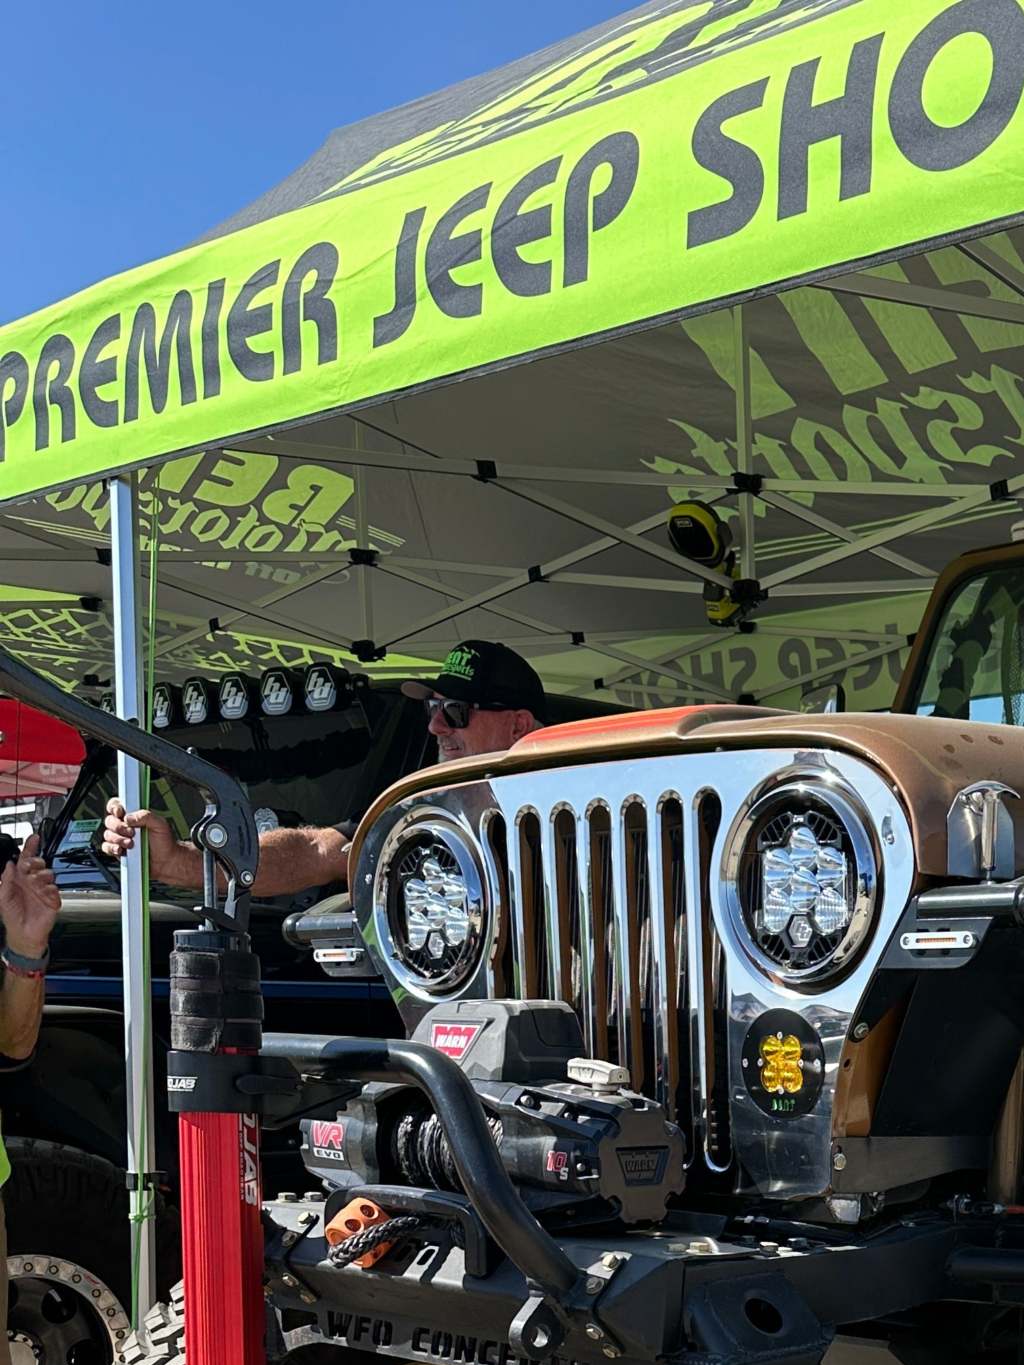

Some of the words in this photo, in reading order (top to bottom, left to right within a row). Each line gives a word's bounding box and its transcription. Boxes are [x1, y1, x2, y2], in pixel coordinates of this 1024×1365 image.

[0, 241, 340, 462] PREMIER
[373, 131, 639, 347] JEEP
[435, 1034, 466, 1049] WARN
[312, 1121, 344, 1150] VR
[315, 1150, 342, 1160] EVO
[547, 1151, 567, 1172] 10
[326, 1310, 393, 1347] WFO
